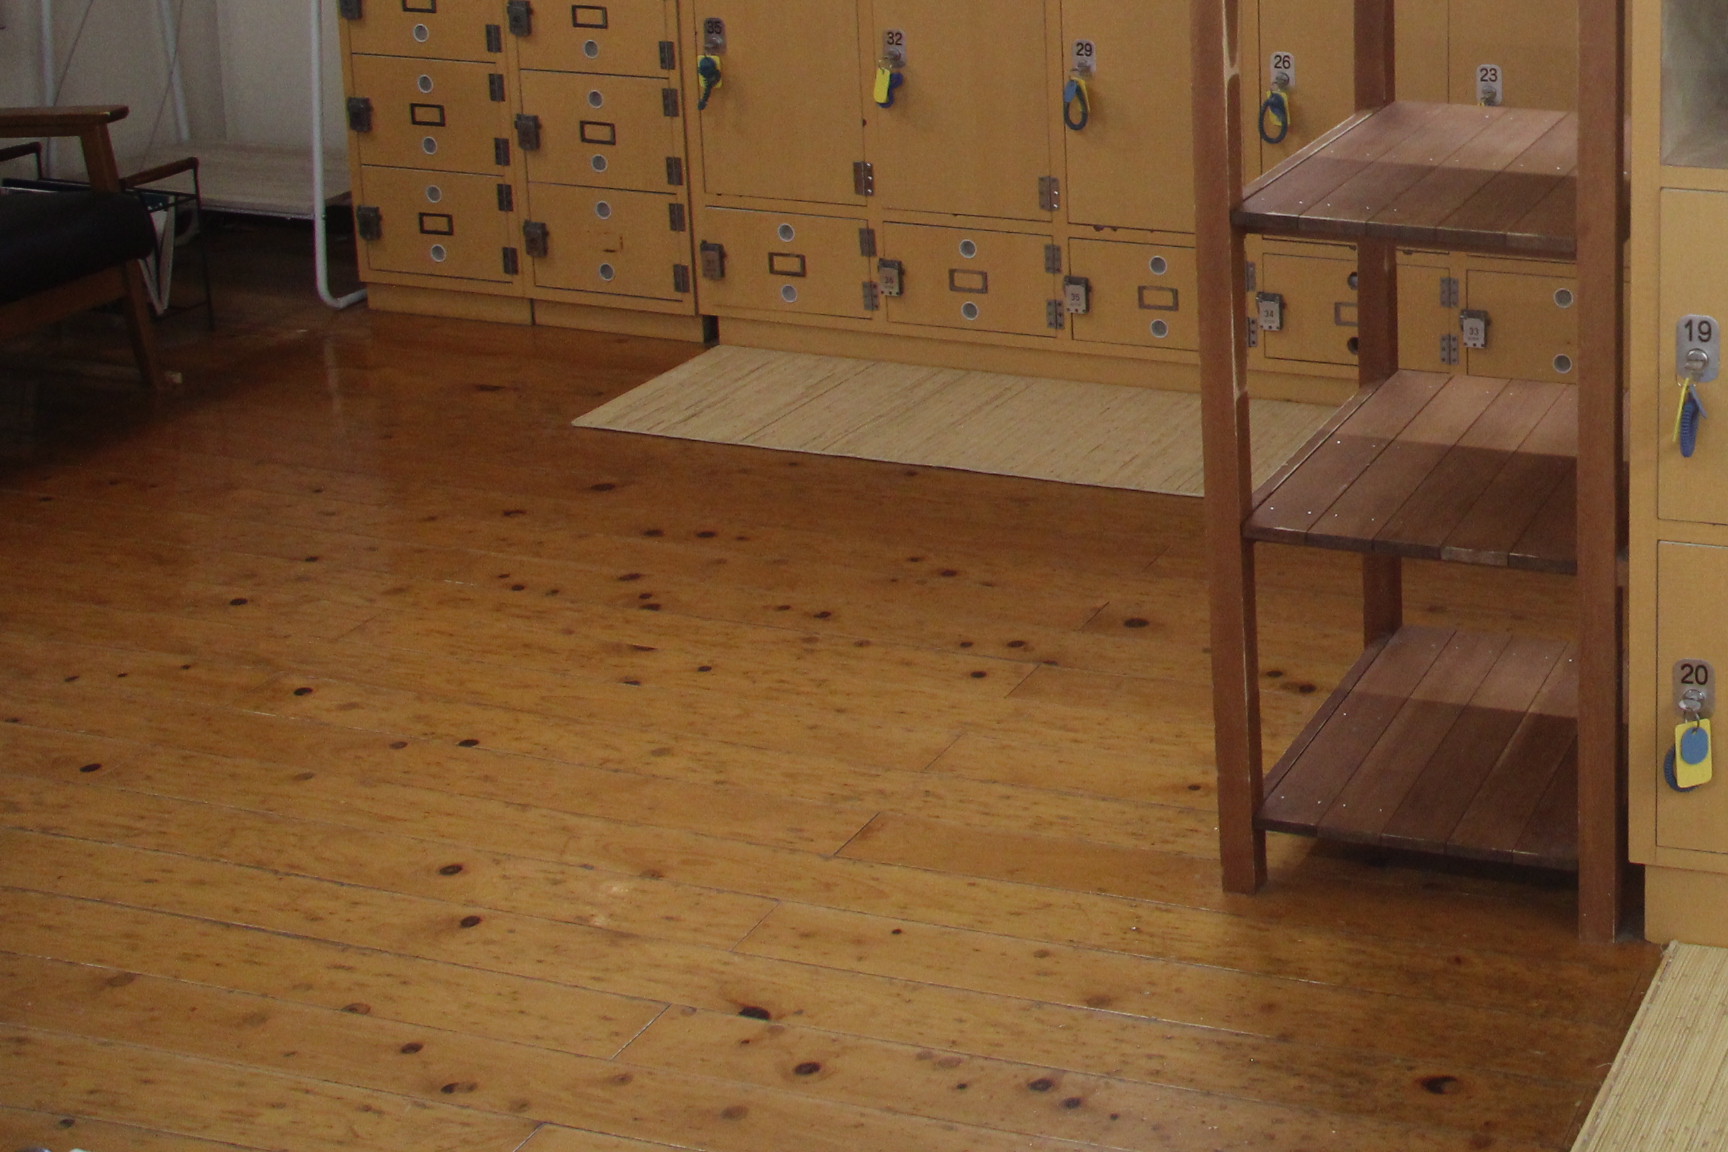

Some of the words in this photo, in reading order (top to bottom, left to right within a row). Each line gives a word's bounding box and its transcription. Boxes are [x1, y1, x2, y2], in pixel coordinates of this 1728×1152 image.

[707, 21, 722, 34] 35
[886, 32, 902, 45] 32
[1076, 43, 1092, 56] 29
[1274, 55, 1290, 68] 26
[1480, 68, 1497, 81] 23
[1071, 293, 1080, 301] 35
[1264, 310, 1274, 318] 34
[1469, 327, 1479, 335] 33
[1684, 320, 1713, 342] 19
[1680, 664, 1709, 684] 20
